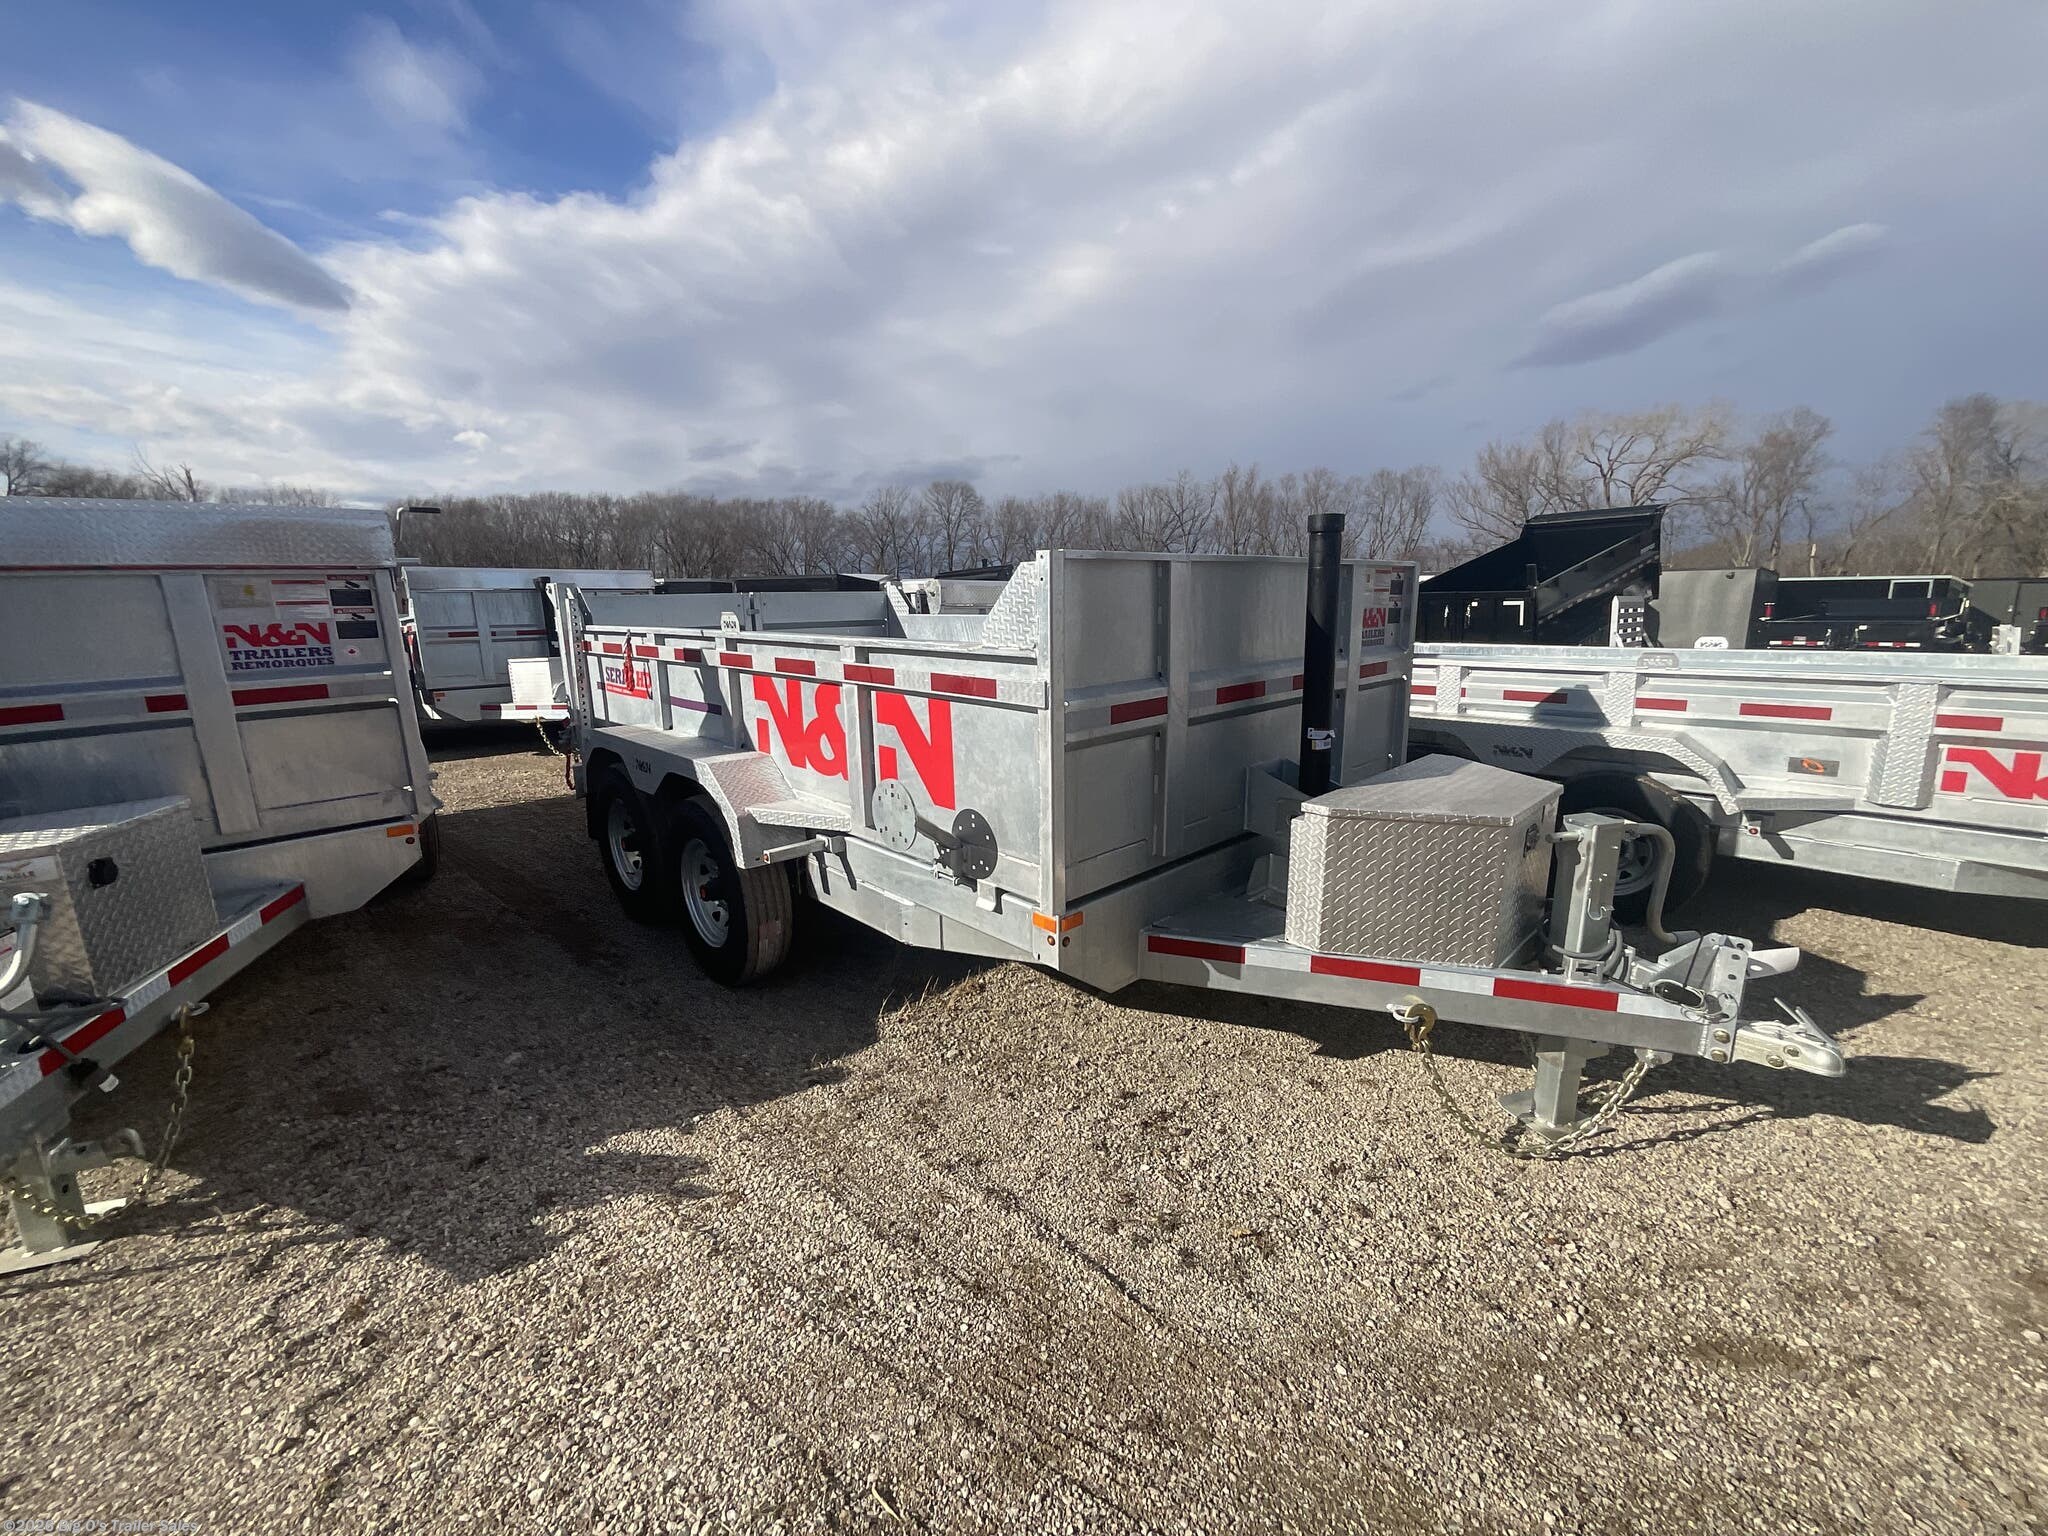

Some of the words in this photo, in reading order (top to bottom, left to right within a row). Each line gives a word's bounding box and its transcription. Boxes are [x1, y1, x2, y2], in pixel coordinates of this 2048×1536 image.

[223, 622, 331, 648] N&N
[229, 647, 333, 661] TRAILERS
[231, 657, 335, 671] REMORQUES
[605, 666, 630, 685] SERI
